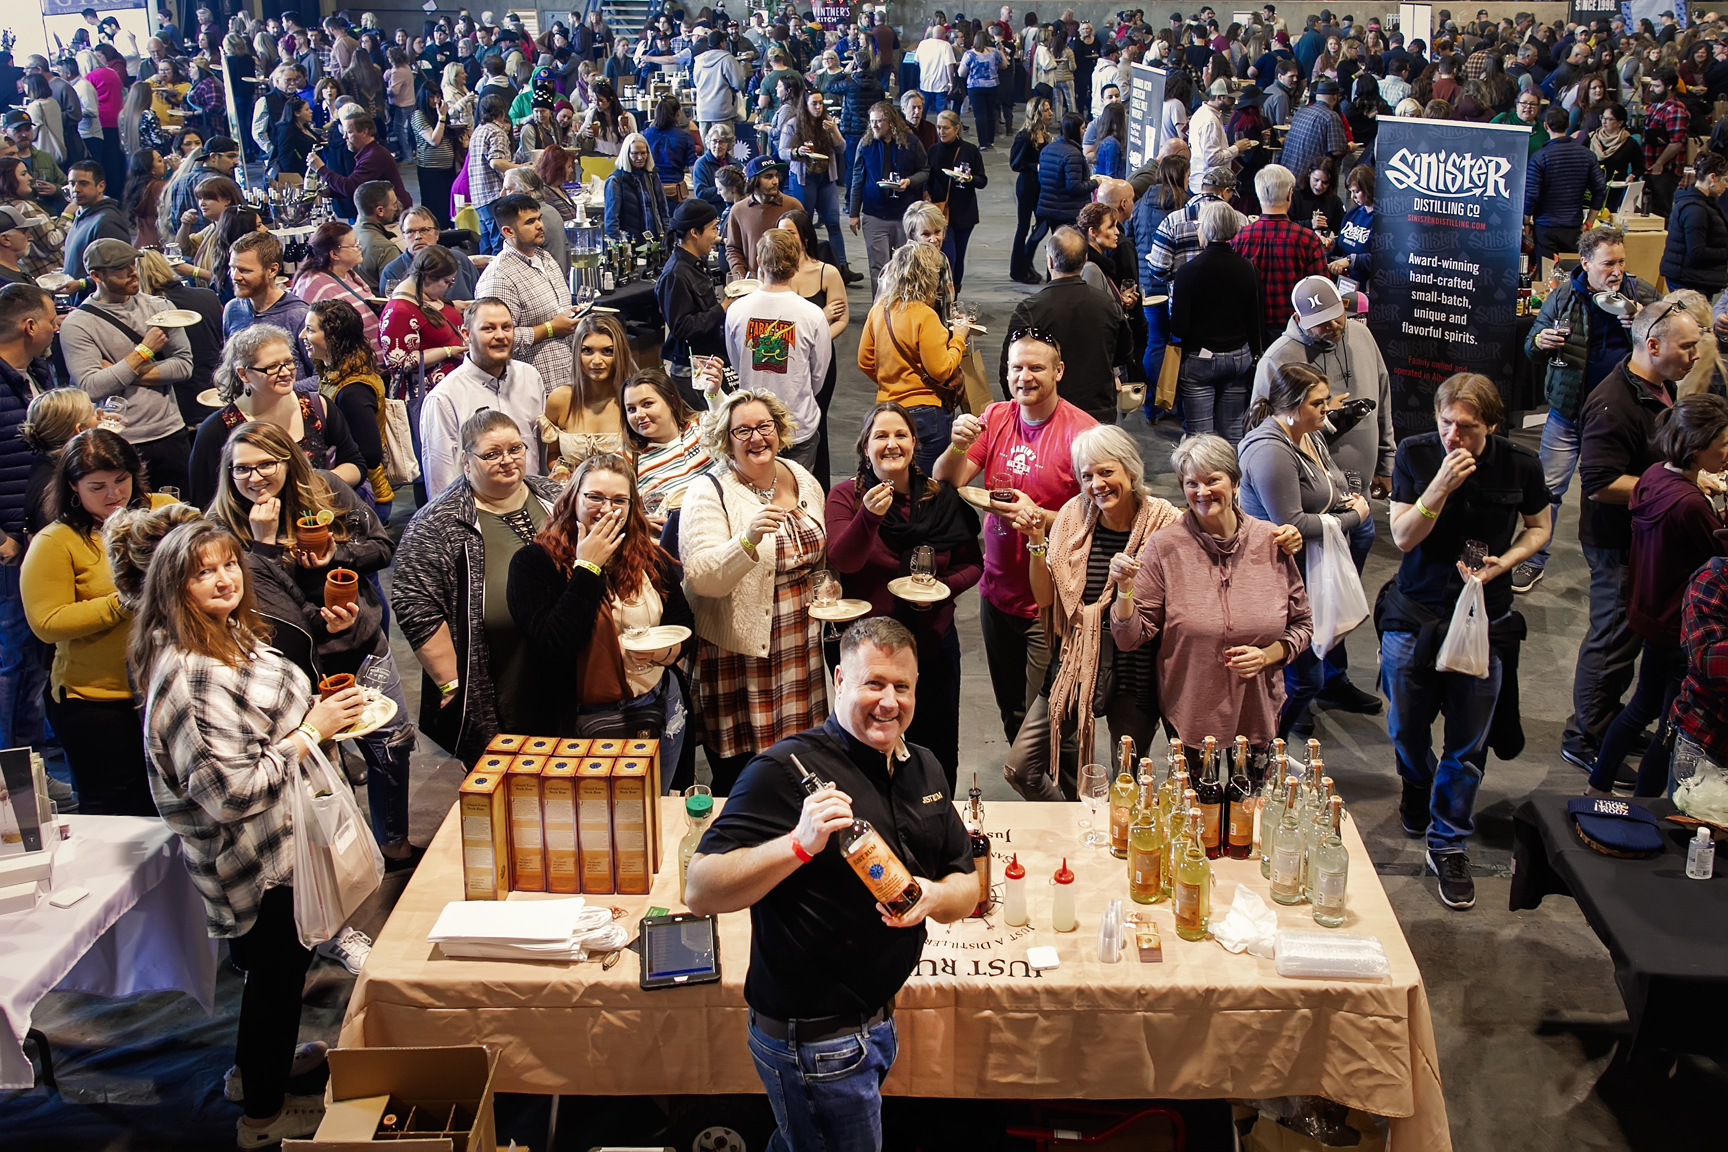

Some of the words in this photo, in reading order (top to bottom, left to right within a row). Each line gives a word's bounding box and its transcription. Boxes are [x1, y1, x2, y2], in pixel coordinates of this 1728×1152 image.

[812, 6, 851, 17] VINTNER'S
[1575, 0, 1597, 11] SINCE
[1597, 0, 1617, 11] 1996.
[1413, 197, 1465, 216] DISTILLING
[1407, 214, 1486, 230] SINISTERDISTILLING.COM
[1408, 252, 1480, 275] Award-winning
[1409, 271, 1476, 292] hand-crafted,
[1411, 290, 1472, 309] small-batch,
[1414, 308, 1447, 322] unique
[1449, 314, 1467, 325] and
[1402, 321, 1442, 339] flavorful
[1444, 330, 1478, 345] spirits.
[1393, 367, 1422, 379] operated
[1423, 371, 1431, 379] in
[1408, 355, 1430, 368] Family
[1431, 361, 1453, 372] owned
[1454, 365, 1468, 373] and
[1009, 923, 1035, 941] JUST
[909, 958, 957, 977] RU
